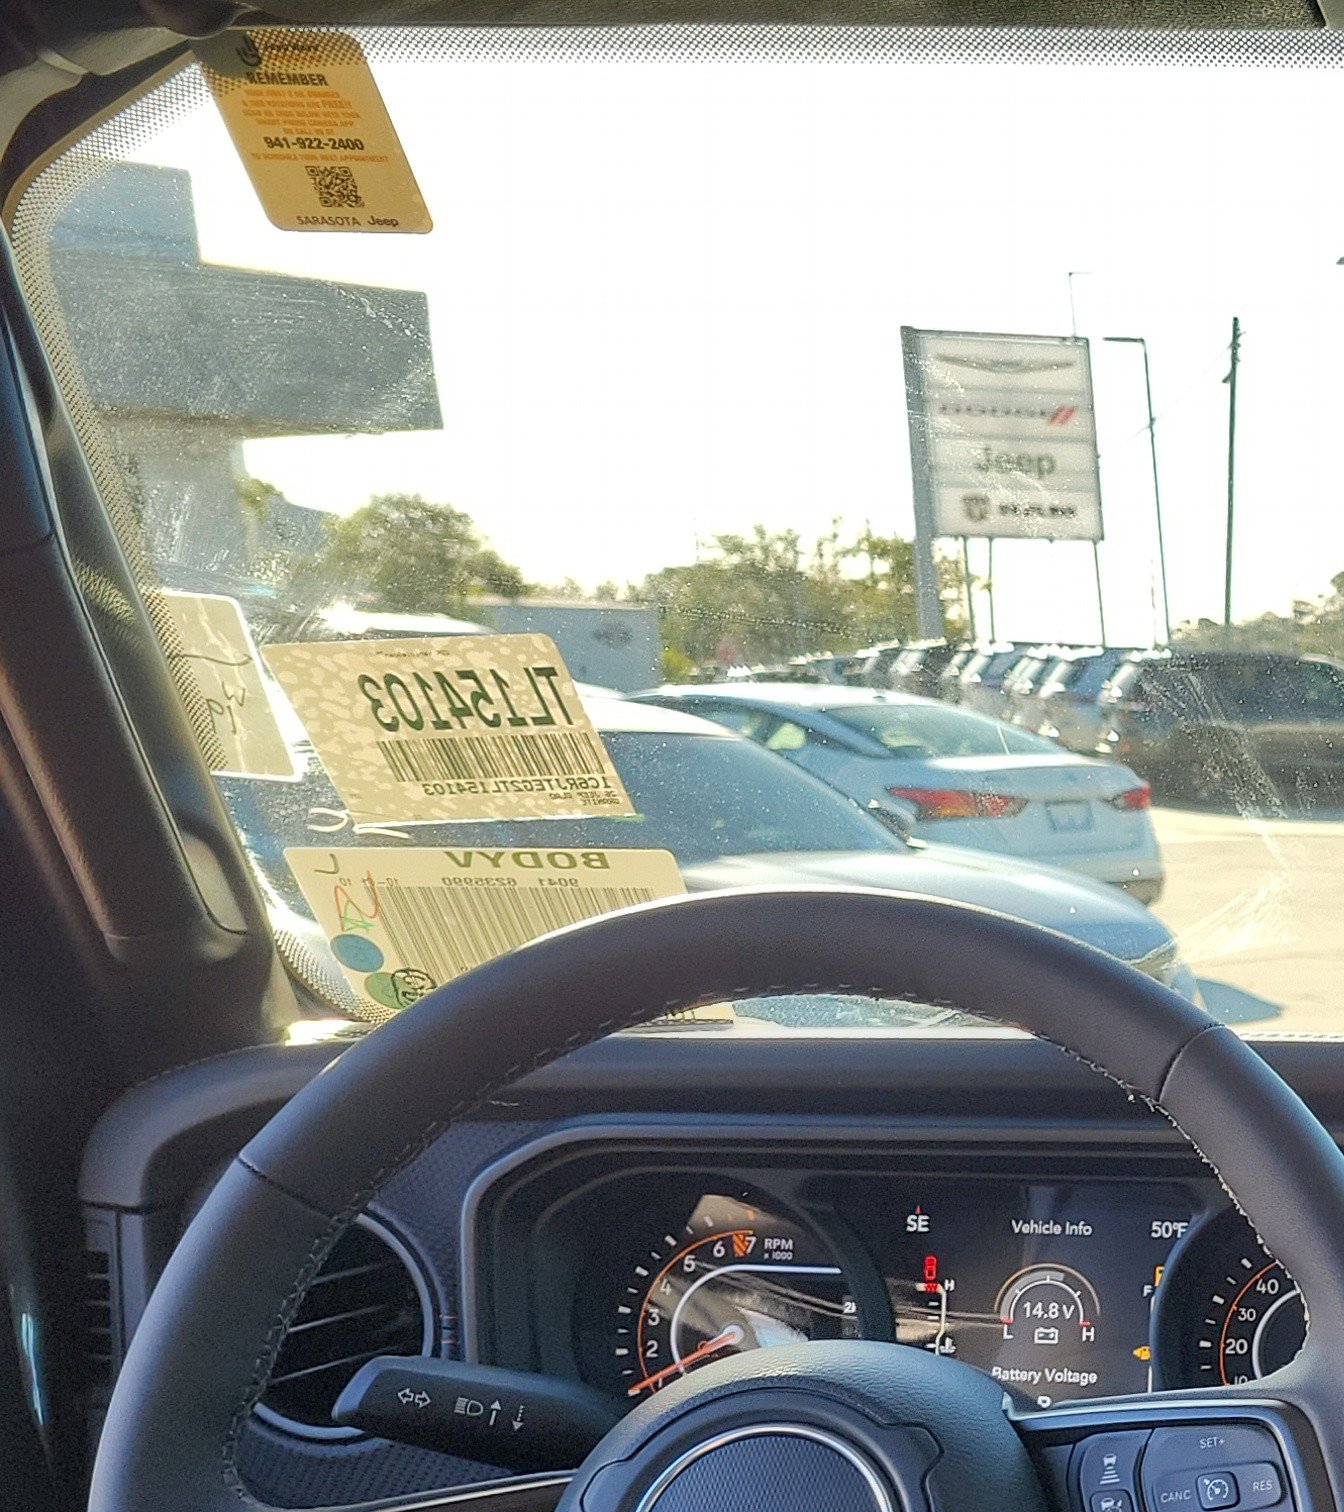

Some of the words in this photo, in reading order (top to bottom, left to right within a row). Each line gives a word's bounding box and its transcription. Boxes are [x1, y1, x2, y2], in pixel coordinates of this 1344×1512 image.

[247, 72, 328, 86] REMEMBER
[264, 136, 364, 150] 941-922-2400
[297, 216, 361, 226] SARASOTA
[368, 215, 399, 227] Jeep
[906, 1215, 930, 1232] SE
[1012, 1219, 1062, 1235] Vehicle
[1065, 1221, 1093, 1236] Info
[713, 1244, 725, 1257] 6
[764, 1238, 793, 1250] RPM
[684, 1255, 696, 1272] 5
[660, 1279, 671, 1295] 4
[1256, 1279, 1279, 1294] 40
[648, 1308, 660, 1326] 3
[1024, 1302, 1059, 1319] 14.8
[1062, 1305, 1075, 1320] V
[1238, 1308, 1256, 1321] 30
[1225, 1339, 1248, 1355] 20
[992, 1367, 1041, 1385] Battery
[1045, 1368, 1097, 1386] Voltage
[1160, 1489, 1191, 1503] CANC
